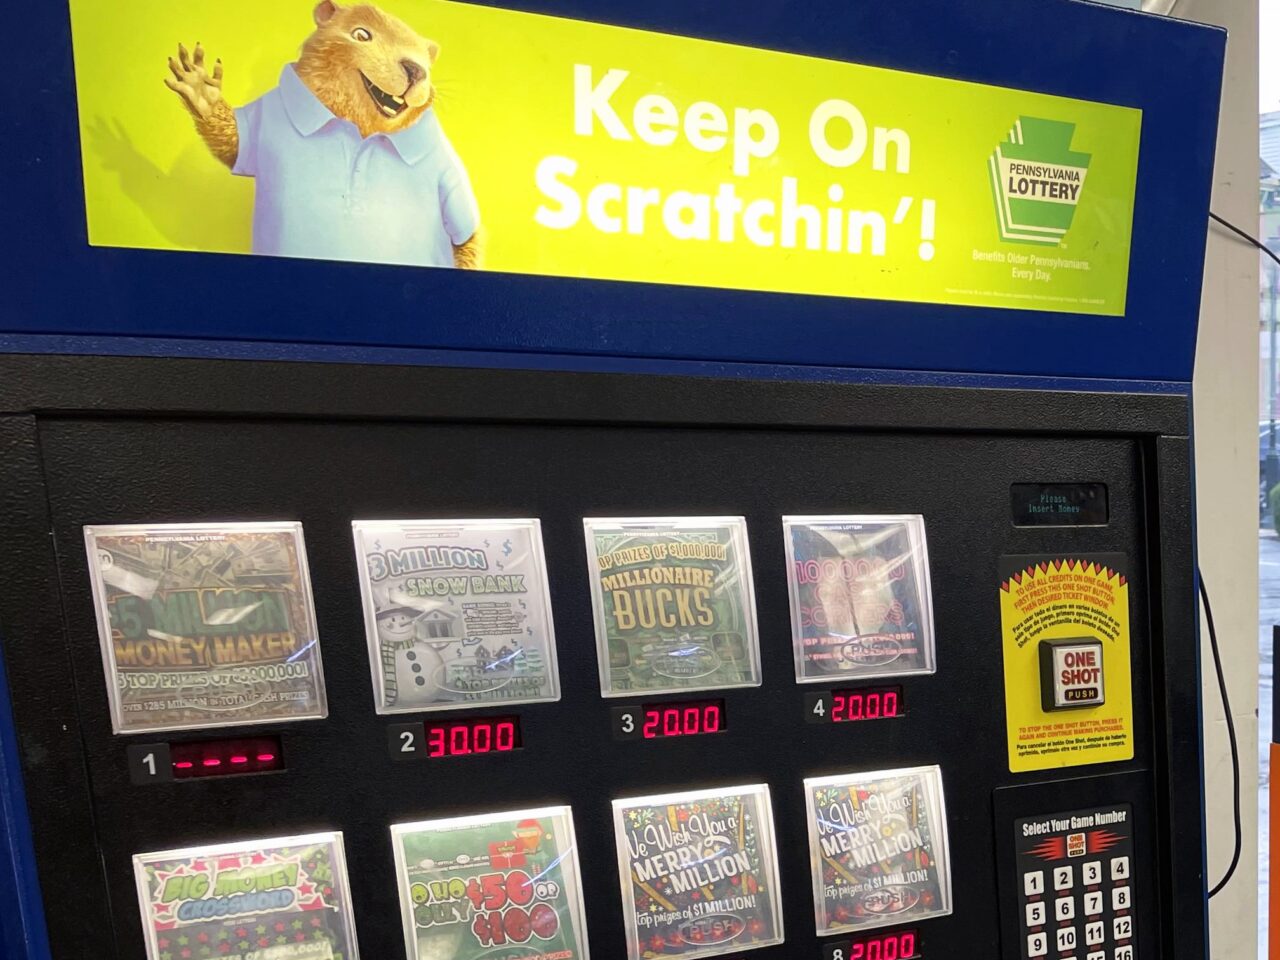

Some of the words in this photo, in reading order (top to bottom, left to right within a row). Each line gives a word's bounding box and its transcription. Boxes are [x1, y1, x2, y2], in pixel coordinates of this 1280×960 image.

[574, 64, 780, 176] Keep
[809, 98, 911, 173] On
[1010, 163, 1080, 181] PENNSYLVANIA
[1009, 177, 1079, 200] LOTTERY
[534, 155, 935, 261] Scratchin'!
[973, 250, 1005, 262] Benefits
[1008, 251, 1028, 264] Older
[1012, 268, 1033, 280] Every
[393, 547, 488, 575] MILLION
[406, 575, 467, 596] SNOW
[471, 575, 527, 594] BANK
[601, 567, 714, 591] MILLIONAIRE
[613, 588, 714, 629] BUCKS
[115, 638, 207, 666] MONEY
[216, 633, 296, 663] MAKER
[1064, 652, 1096, 668] ONE
[1062, 668, 1099, 685] SHOT
[1069, 690, 1094, 698] PUSH
[814, 699, 825, 716] 4
[622, 714, 634, 732] 3
[401, 732, 415, 751] 2
[142, 754, 156, 775] 1
[1023, 821, 1050, 836] Select
[1051, 818, 1069, 832] Your
[1071, 814, 1093, 829] Game
[1095, 810, 1126, 825] Number
[634, 842, 704, 882] MERRY
[670, 851, 750, 896] MILLION
[161, 873, 210, 903] BIG
[214, 863, 298, 895] MONEY
[177, 890, 295, 921] CROSSWORD
